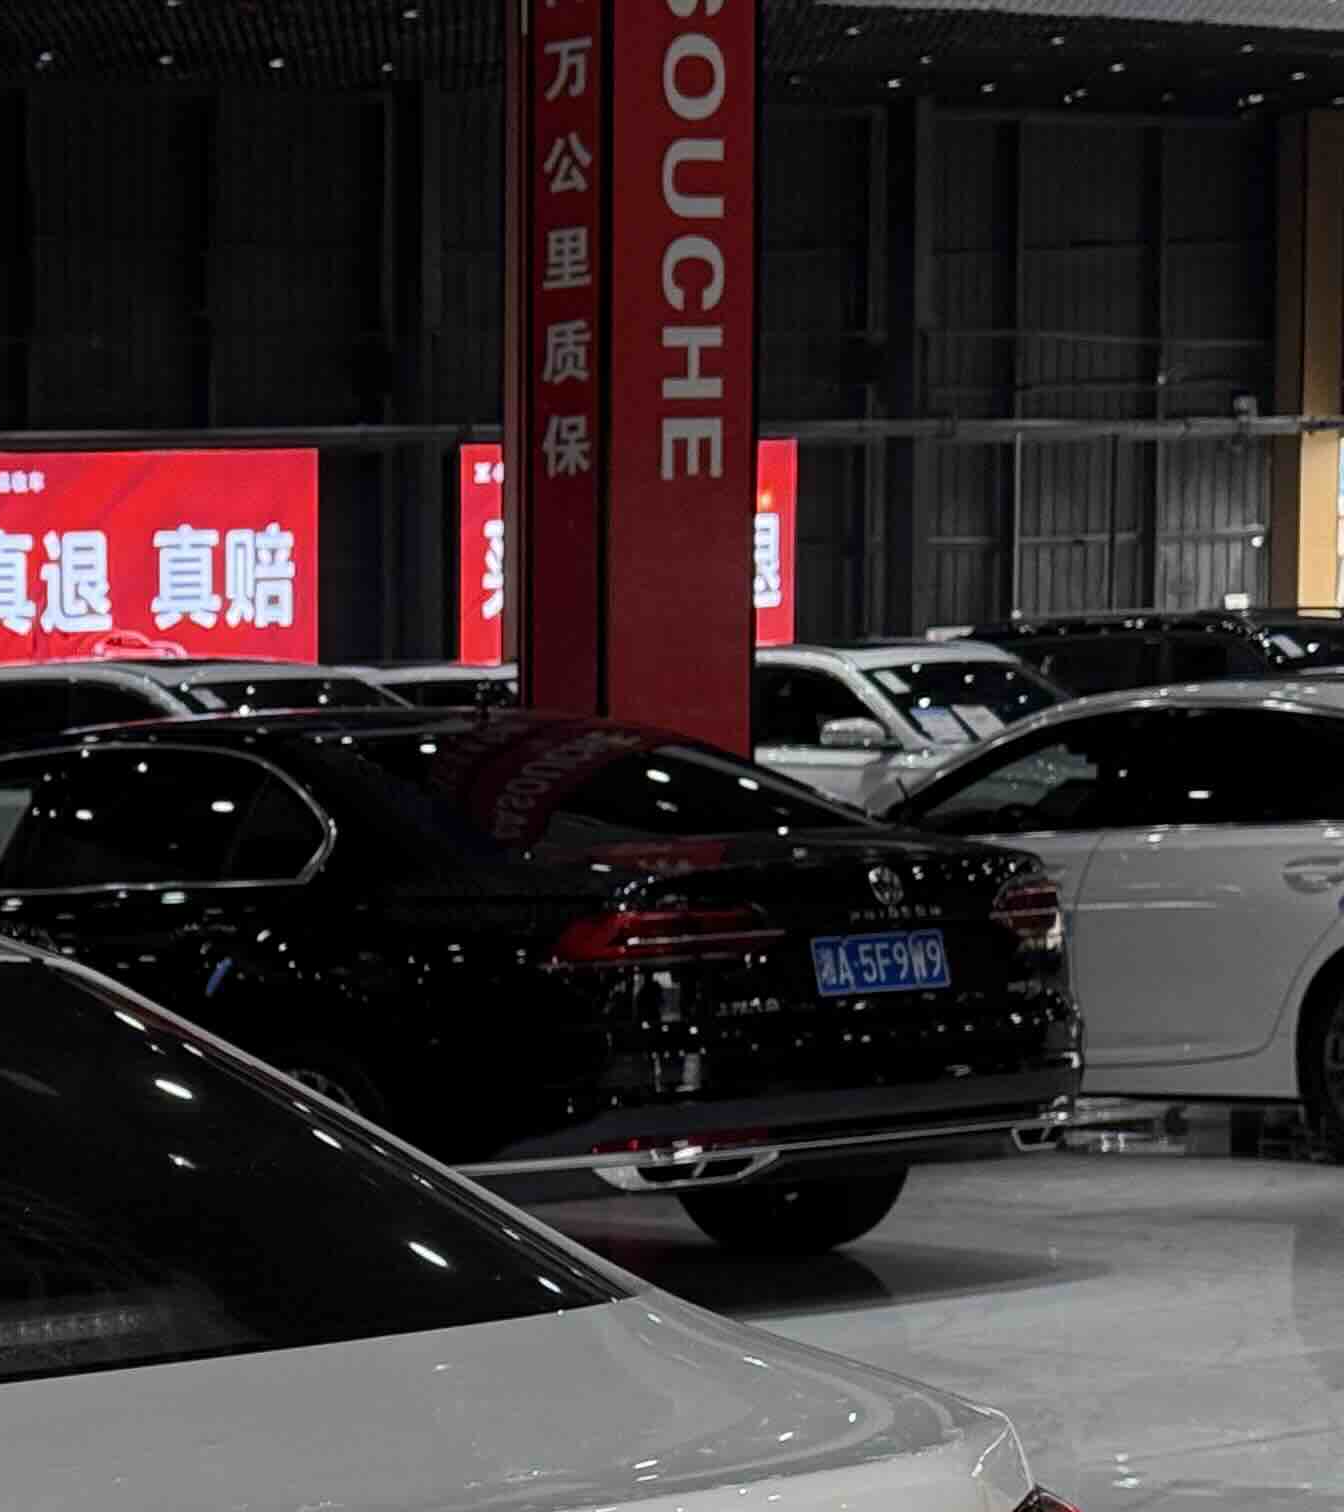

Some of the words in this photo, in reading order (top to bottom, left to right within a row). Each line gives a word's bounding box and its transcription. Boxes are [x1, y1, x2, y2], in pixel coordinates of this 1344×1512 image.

[543, 0, 593, 477] 万公里质保
[661, 0, 726, 480] OUCHE
[151, 523, 296, 632] 真赔
